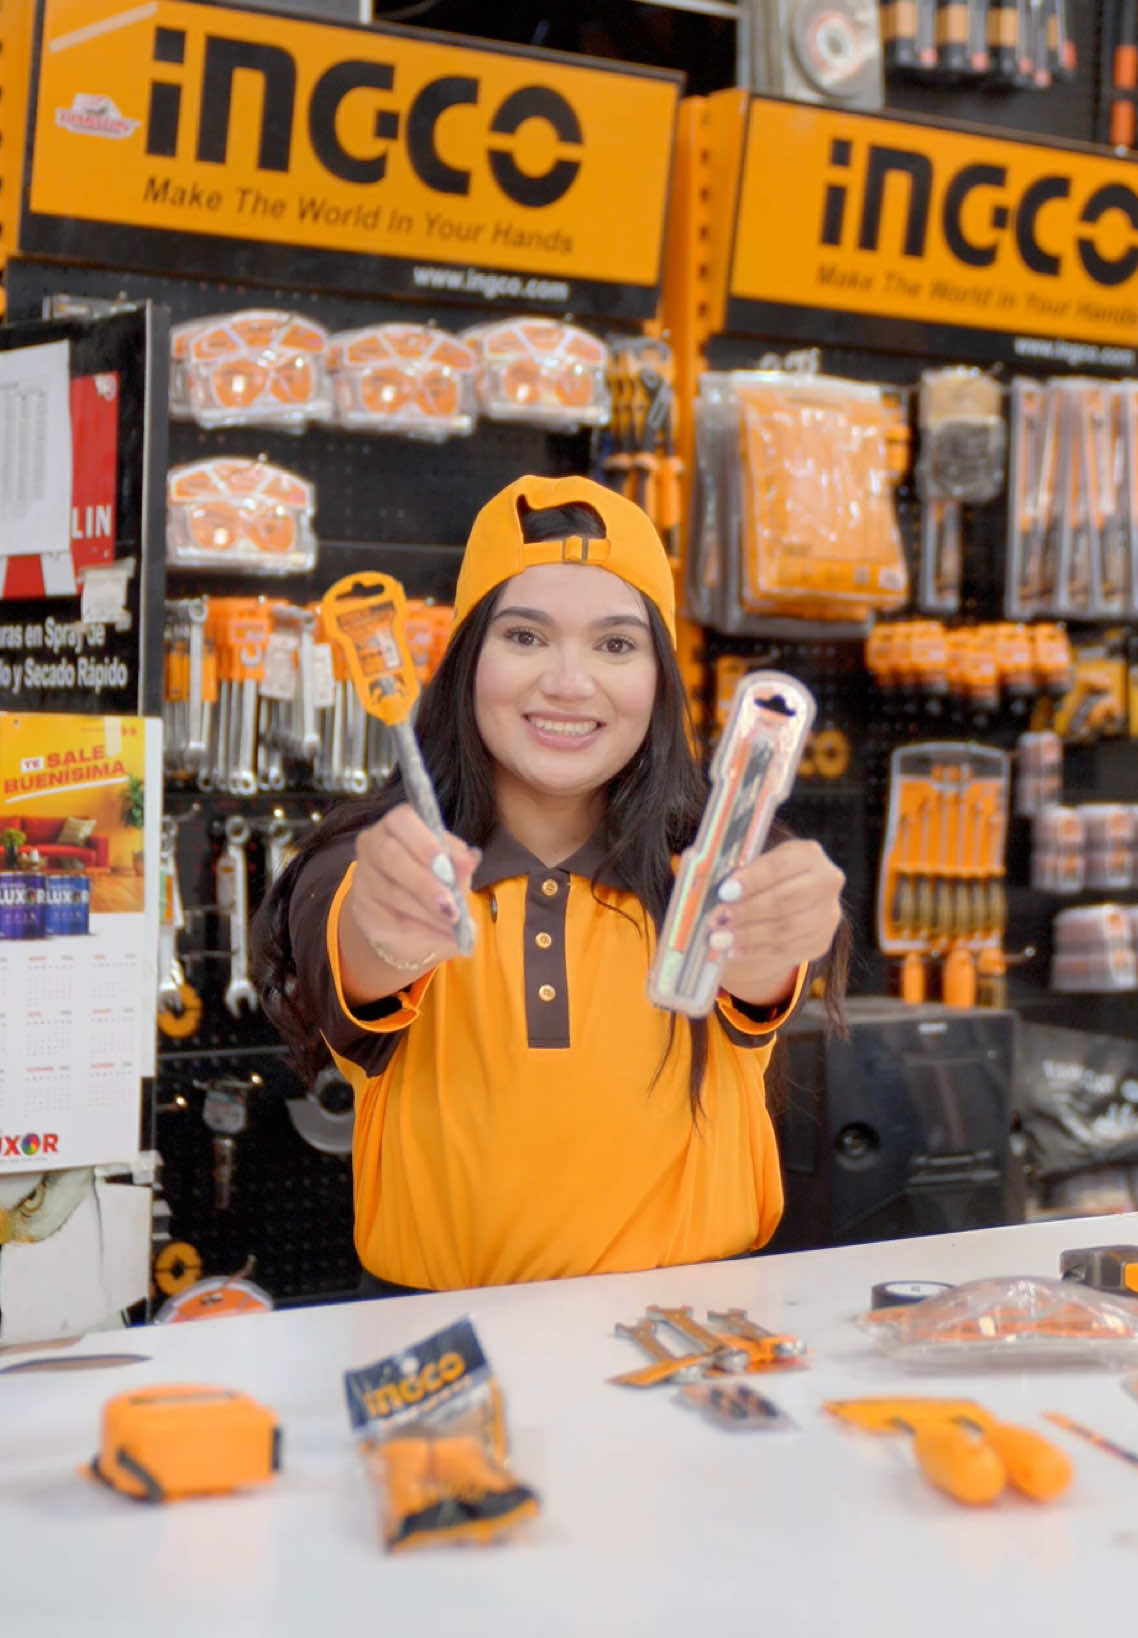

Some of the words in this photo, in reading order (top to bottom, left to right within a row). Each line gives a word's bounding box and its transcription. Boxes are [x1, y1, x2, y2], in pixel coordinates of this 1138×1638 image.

[143, 177, 223, 213] Make
[236, 186, 287, 218] The
[298, 197, 381, 231] World
[424, 211, 484, 242] Your
[491, 219, 574, 253] Hands
[412, 265, 571, 303] www.ingco.com
[815, 264, 873, 292] Make
[883, 271, 921, 298] The
[24, 623, 43, 649] en
[45, 616, 83, 655] Spray
[12, 663, 23, 696] y
[24, 656, 76, 689] Secado
[77, 655, 128, 696] Rápido
[46, 744, 105, 769] SALE
[4, 760, 126, 794] BUENÍSIMA
